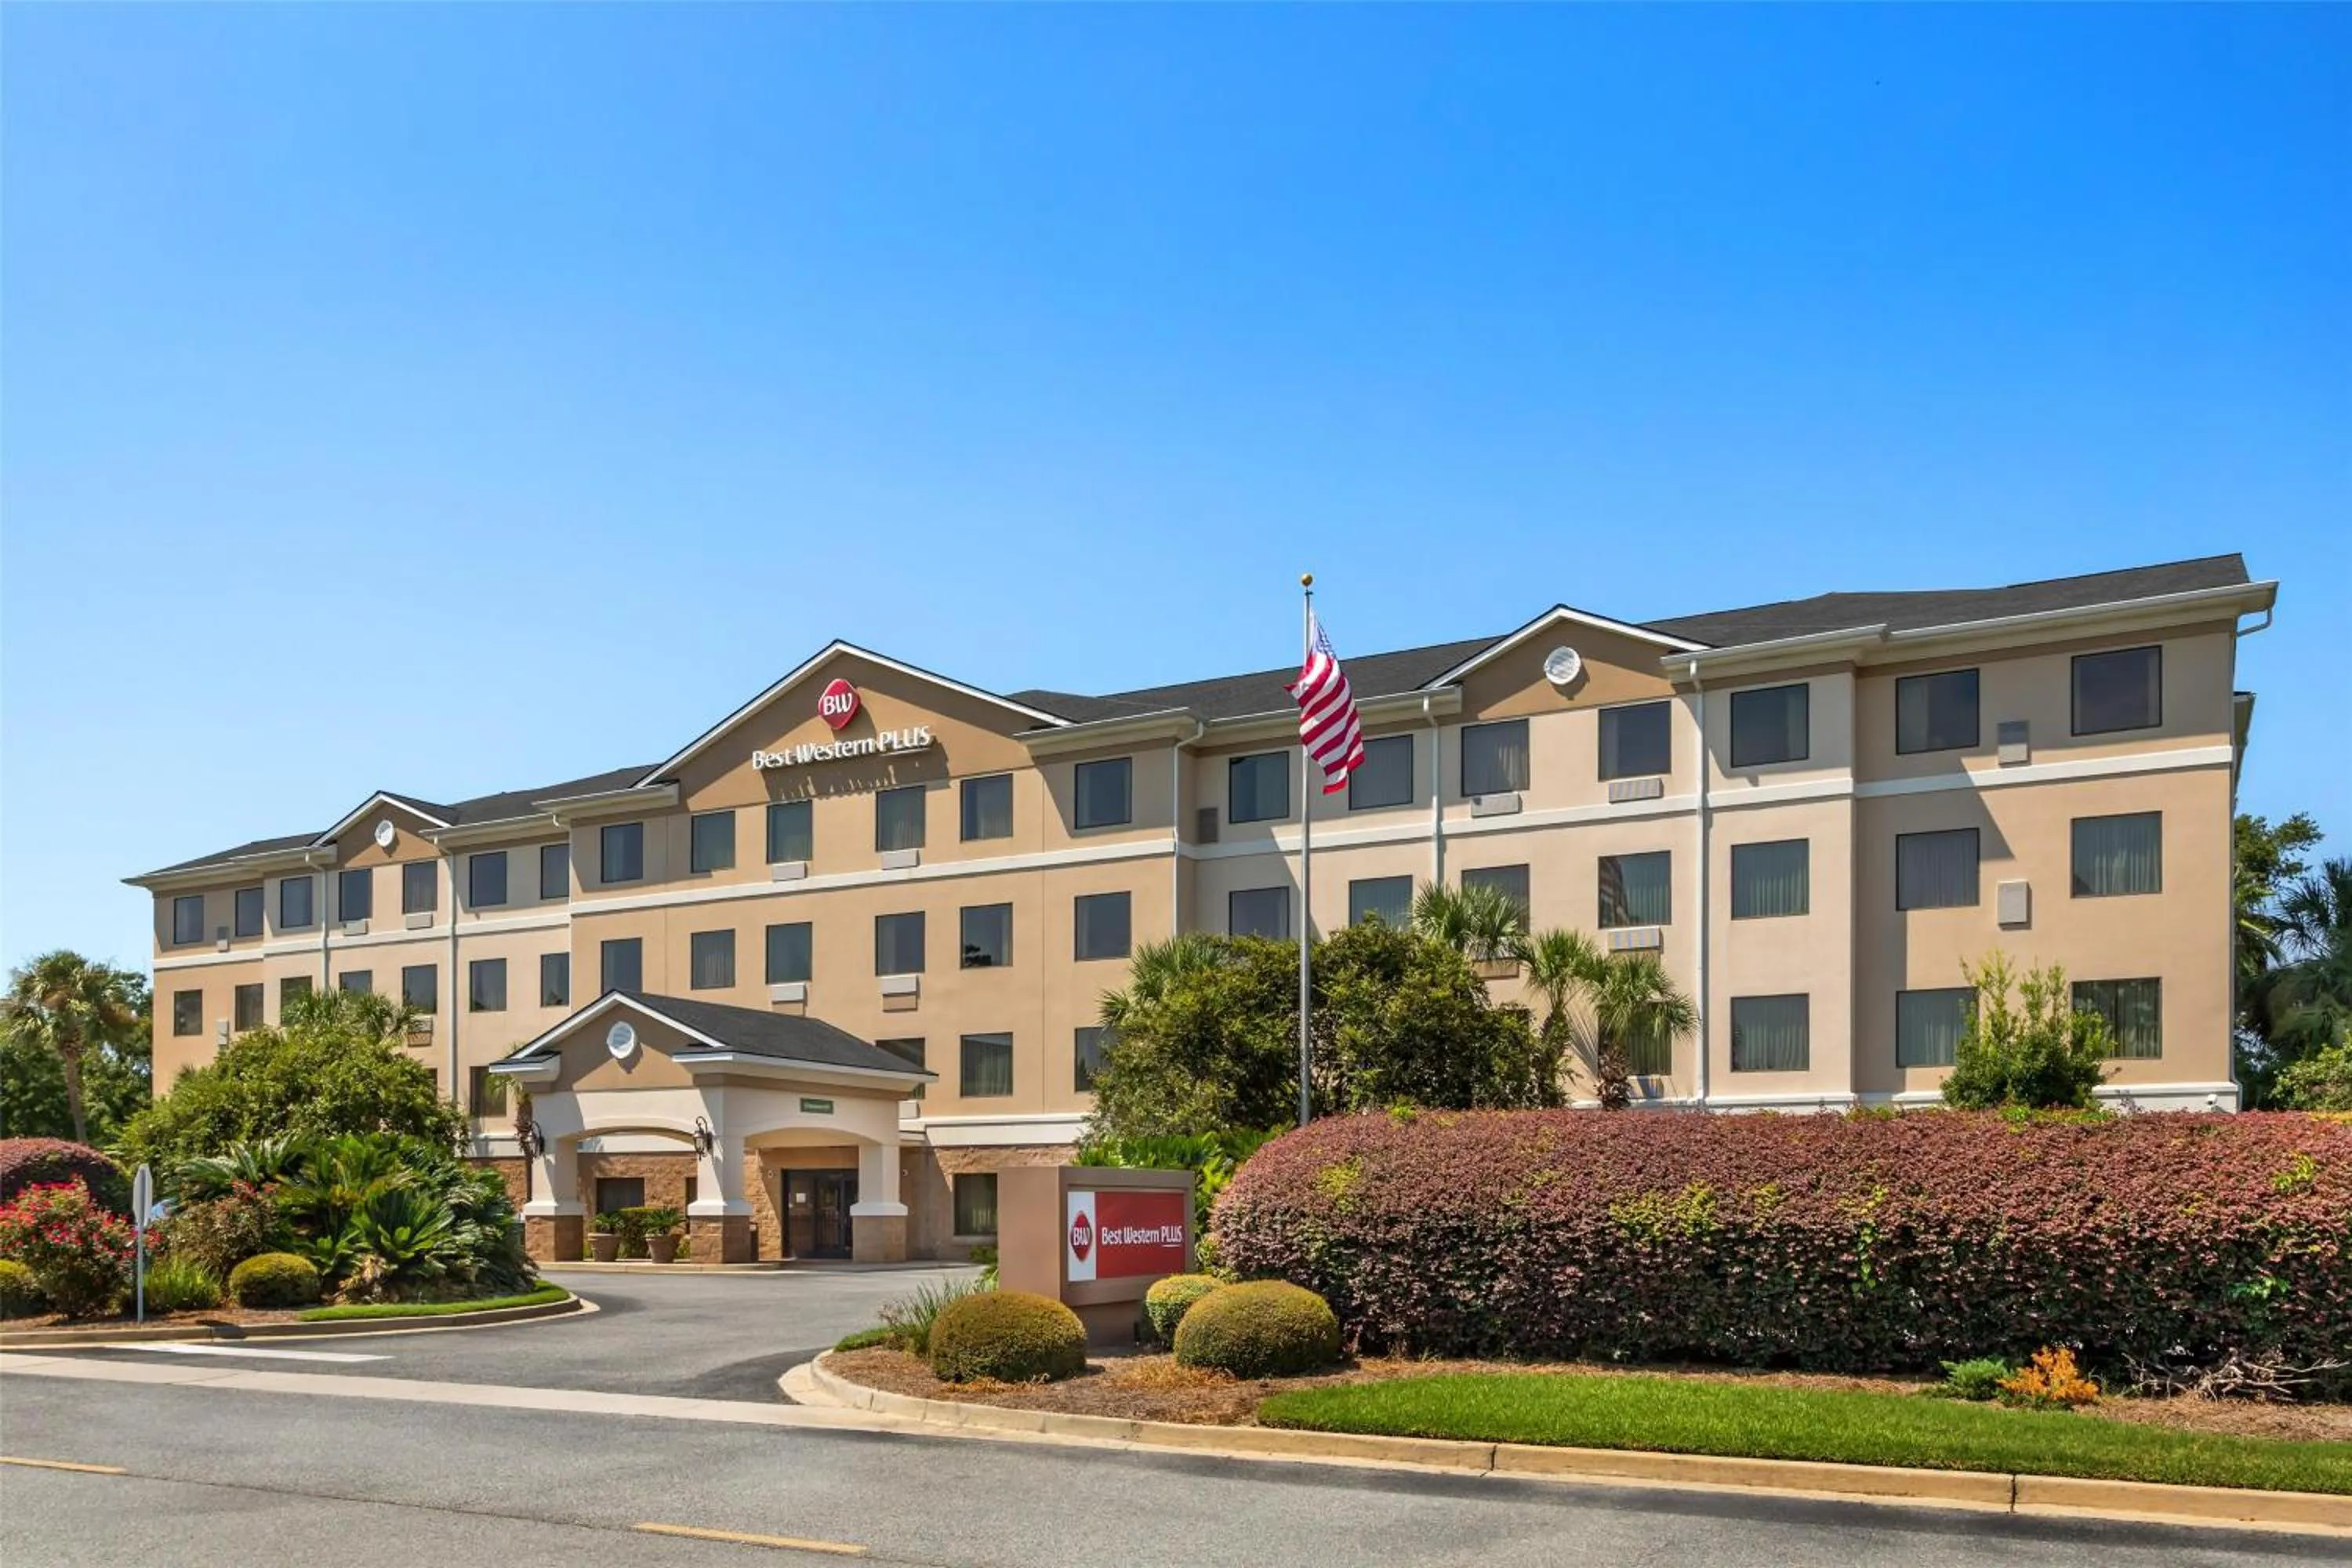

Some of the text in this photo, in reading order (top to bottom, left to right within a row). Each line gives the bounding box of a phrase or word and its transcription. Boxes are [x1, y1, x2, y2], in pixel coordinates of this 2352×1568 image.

[823, 693, 852, 715] BW
[753, 726, 931, 770] Best Western PLUS
[1073, 1227, 1091, 1246] BW
[1102, 1225, 1183, 1245] Best Western PLUS
